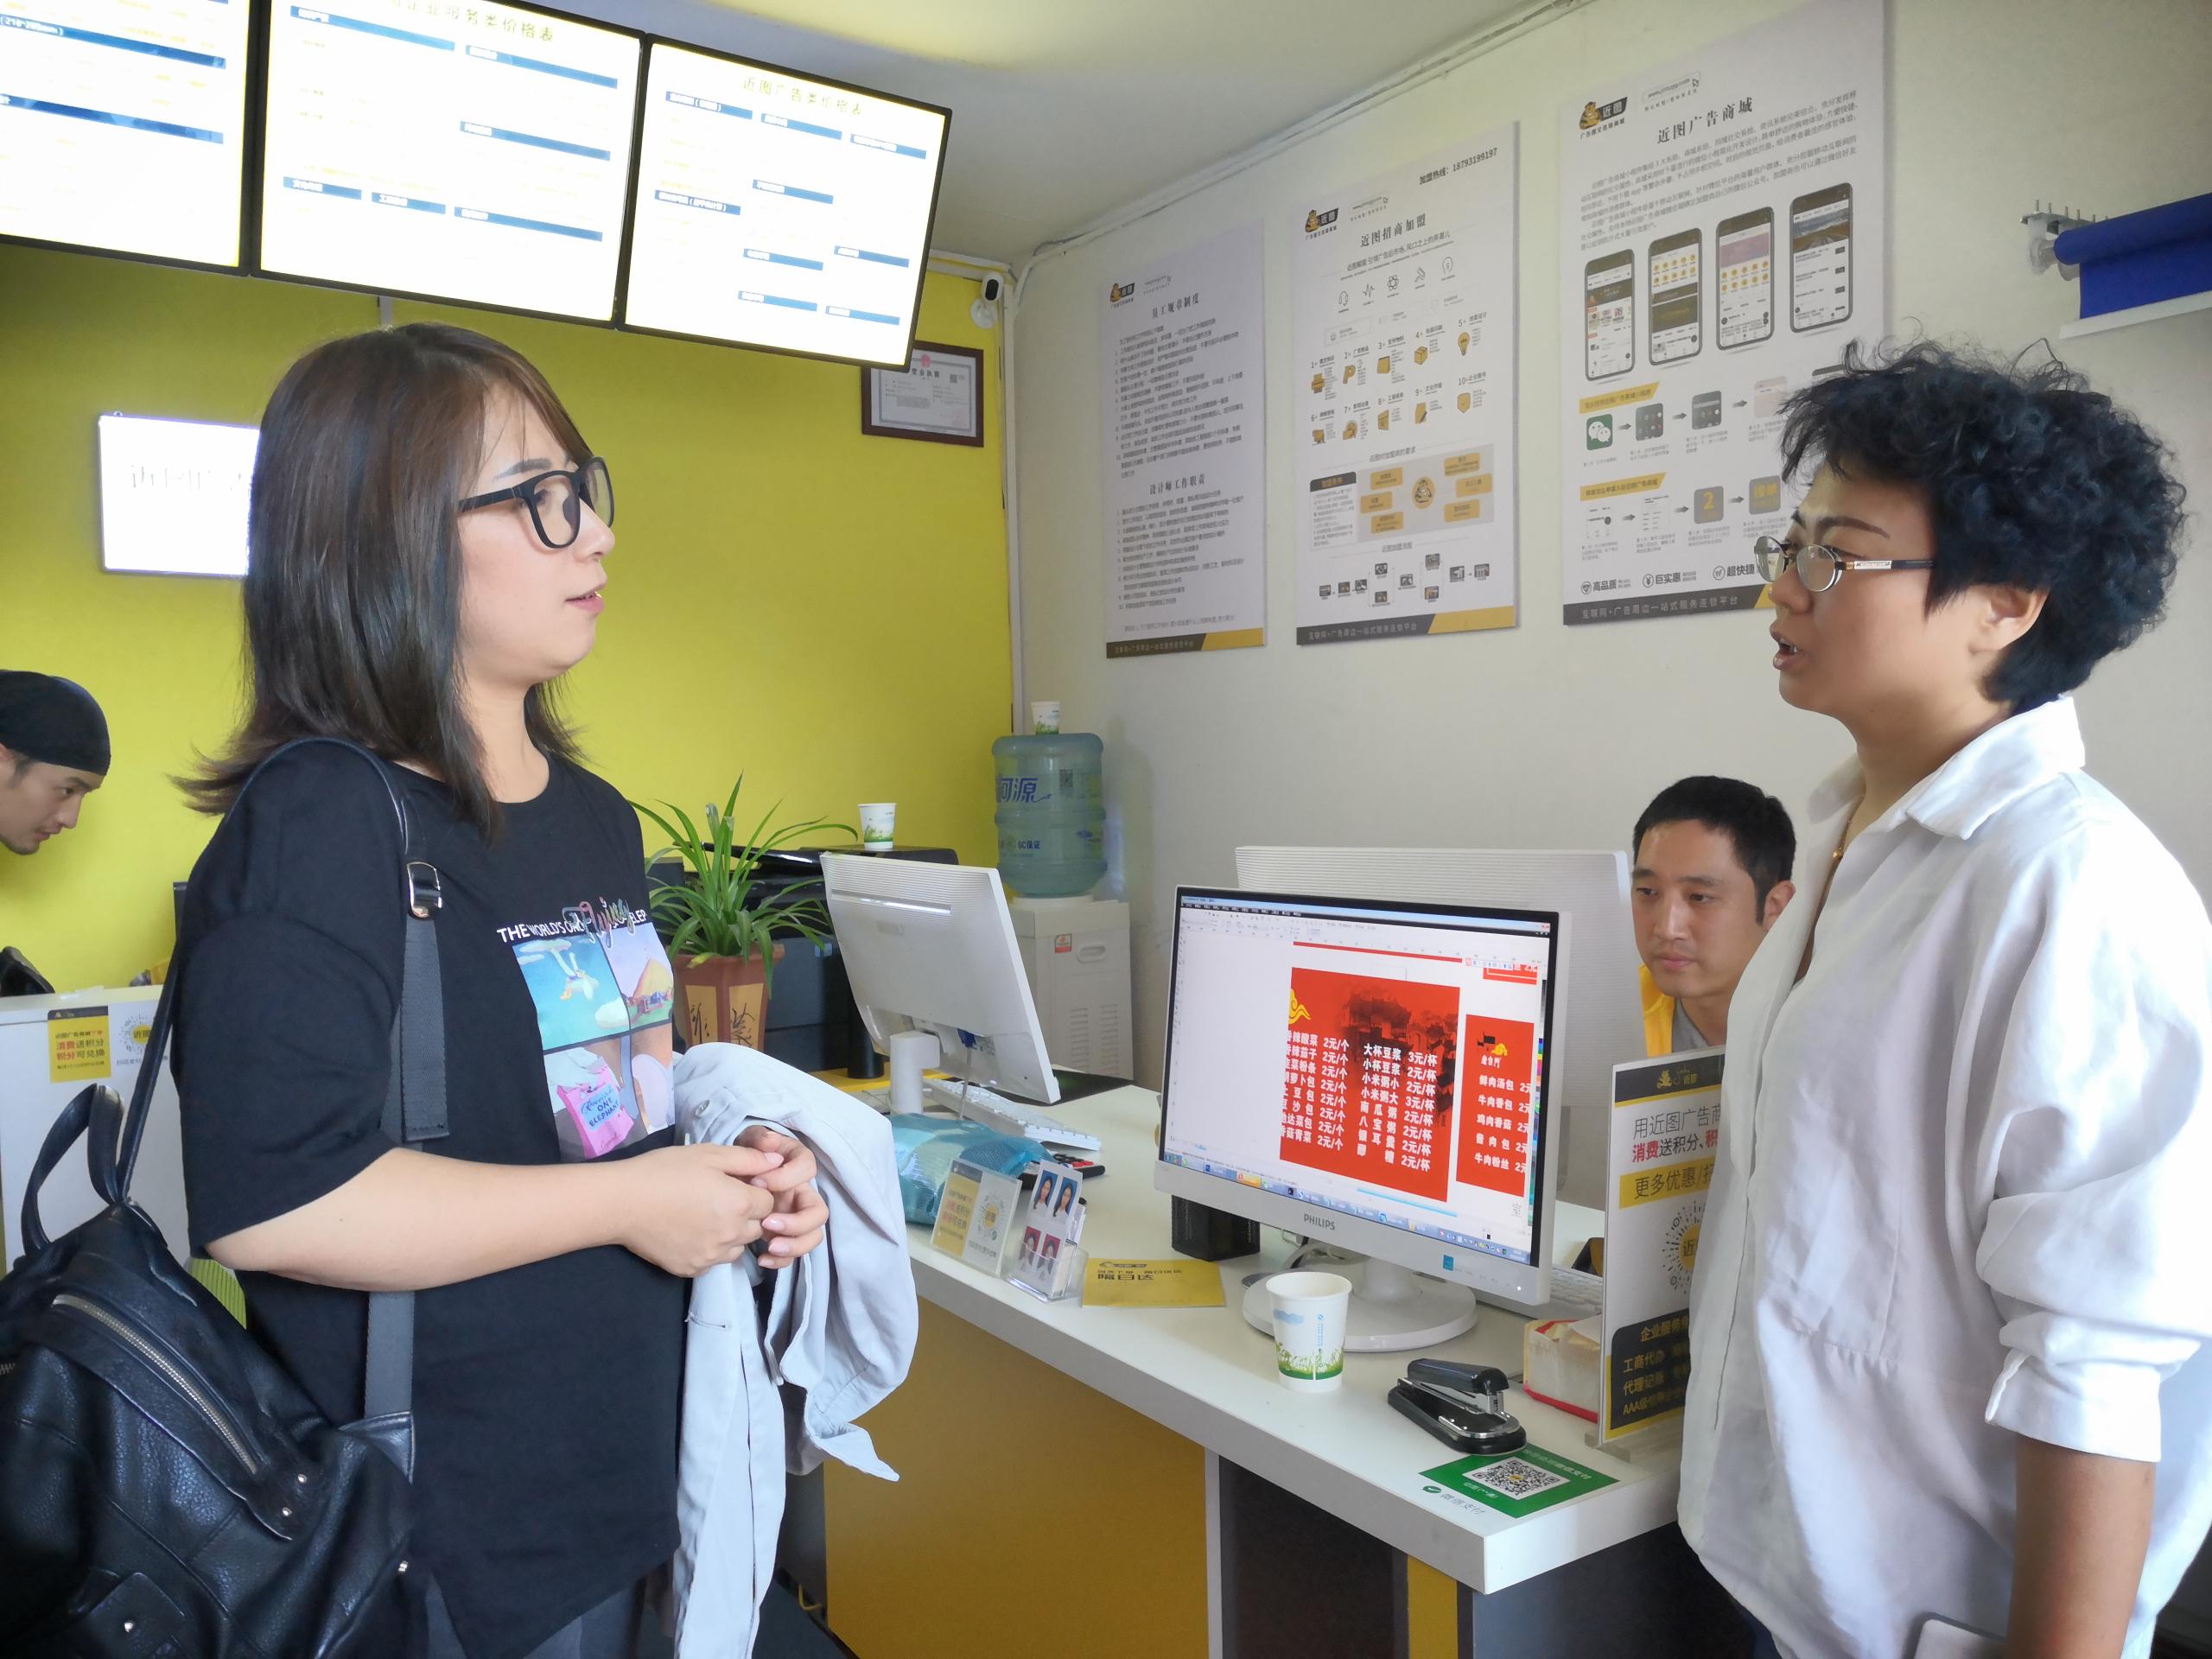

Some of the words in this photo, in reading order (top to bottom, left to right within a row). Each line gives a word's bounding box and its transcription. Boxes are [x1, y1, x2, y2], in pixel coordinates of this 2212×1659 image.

[1657, 97, 1753, 144] 近图广告商城
[1360, 213, 1426, 248] 近图招商加盟
[1592, 579, 1618, 592] 高品质
[1655, 572, 1681, 585] 巨实惠
[1726, 563, 1755, 577] 超快捷
[497, 923, 531, 943] THE
[56, 1039, 104, 1051] 消费送积分
[1323, 1038, 1349, 1052] 2元/个
[57, 1049, 105, 1061] 积分可兑换
[1322, 1052, 1348, 1066] 2元/个
[1363, 1042, 1402, 1061] 大杯豆浆
[1408, 1052, 1438, 1067] 3元/杯
[1321, 1065, 1348, 1080] 2元/个
[1363, 1058, 1400, 1076] 小杯豆浆
[1407, 1066, 1437, 1083] 2元/杯
[1320, 1079, 1347, 1095] 2元/个
[1362, 1072, 1399, 1090] 小米粥小
[1406, 1081, 1436, 1097] 2元/杯
[598, 1097, 613, 1111] ONE
[1320, 1093, 1346, 1109] 2元/个
[1361, 1087, 1398, 1105] 小米粥大
[1405, 1096, 1434, 1112] 3元/杯
[588, 1100, 619, 1127] ELEPHANT
[1319, 1107, 1346, 1123] 2元/个
[1403, 1110, 1433, 1127] 2元/杯
[1319, 1121, 1344, 1137] 2元/个
[1402, 1125, 1433, 1141] 2元/杯
[1317, 1135, 1344, 1151] 2元/个
[1402, 1140, 1431, 1157] 2元/杯
[1401, 1154, 1430, 1172] 2元/杯
[1303, 1213, 1336, 1230] PHILIPS
